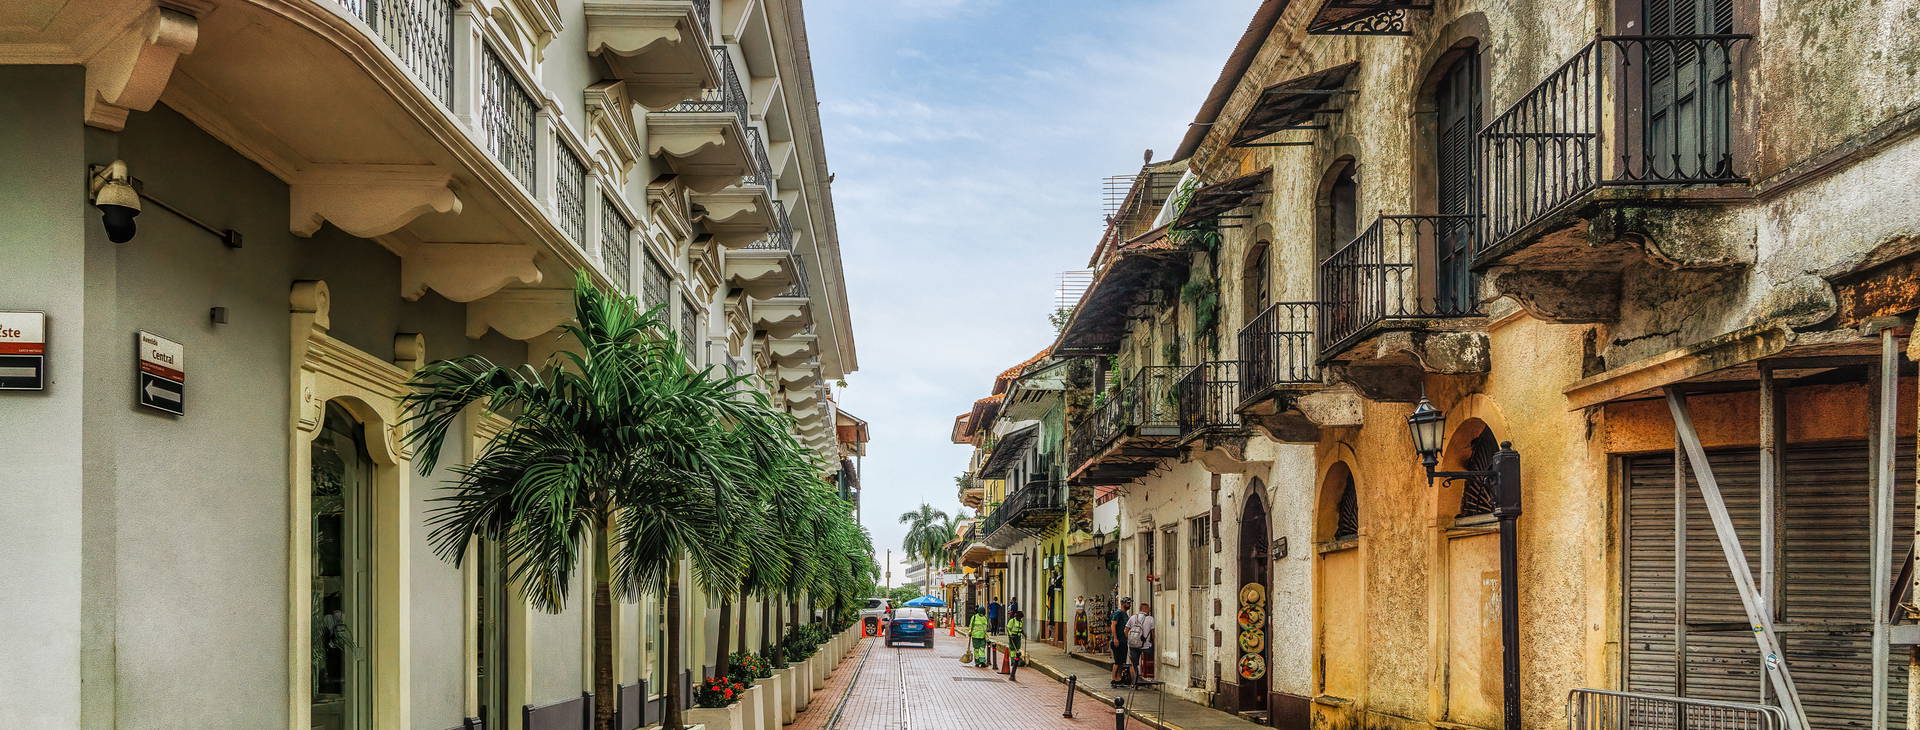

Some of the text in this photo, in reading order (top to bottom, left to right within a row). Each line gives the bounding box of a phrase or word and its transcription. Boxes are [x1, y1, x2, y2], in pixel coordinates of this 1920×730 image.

[0, 327, 21, 338] ste
[143, 336, 158, 346] Avenida
[152, 350, 174, 364] Central
